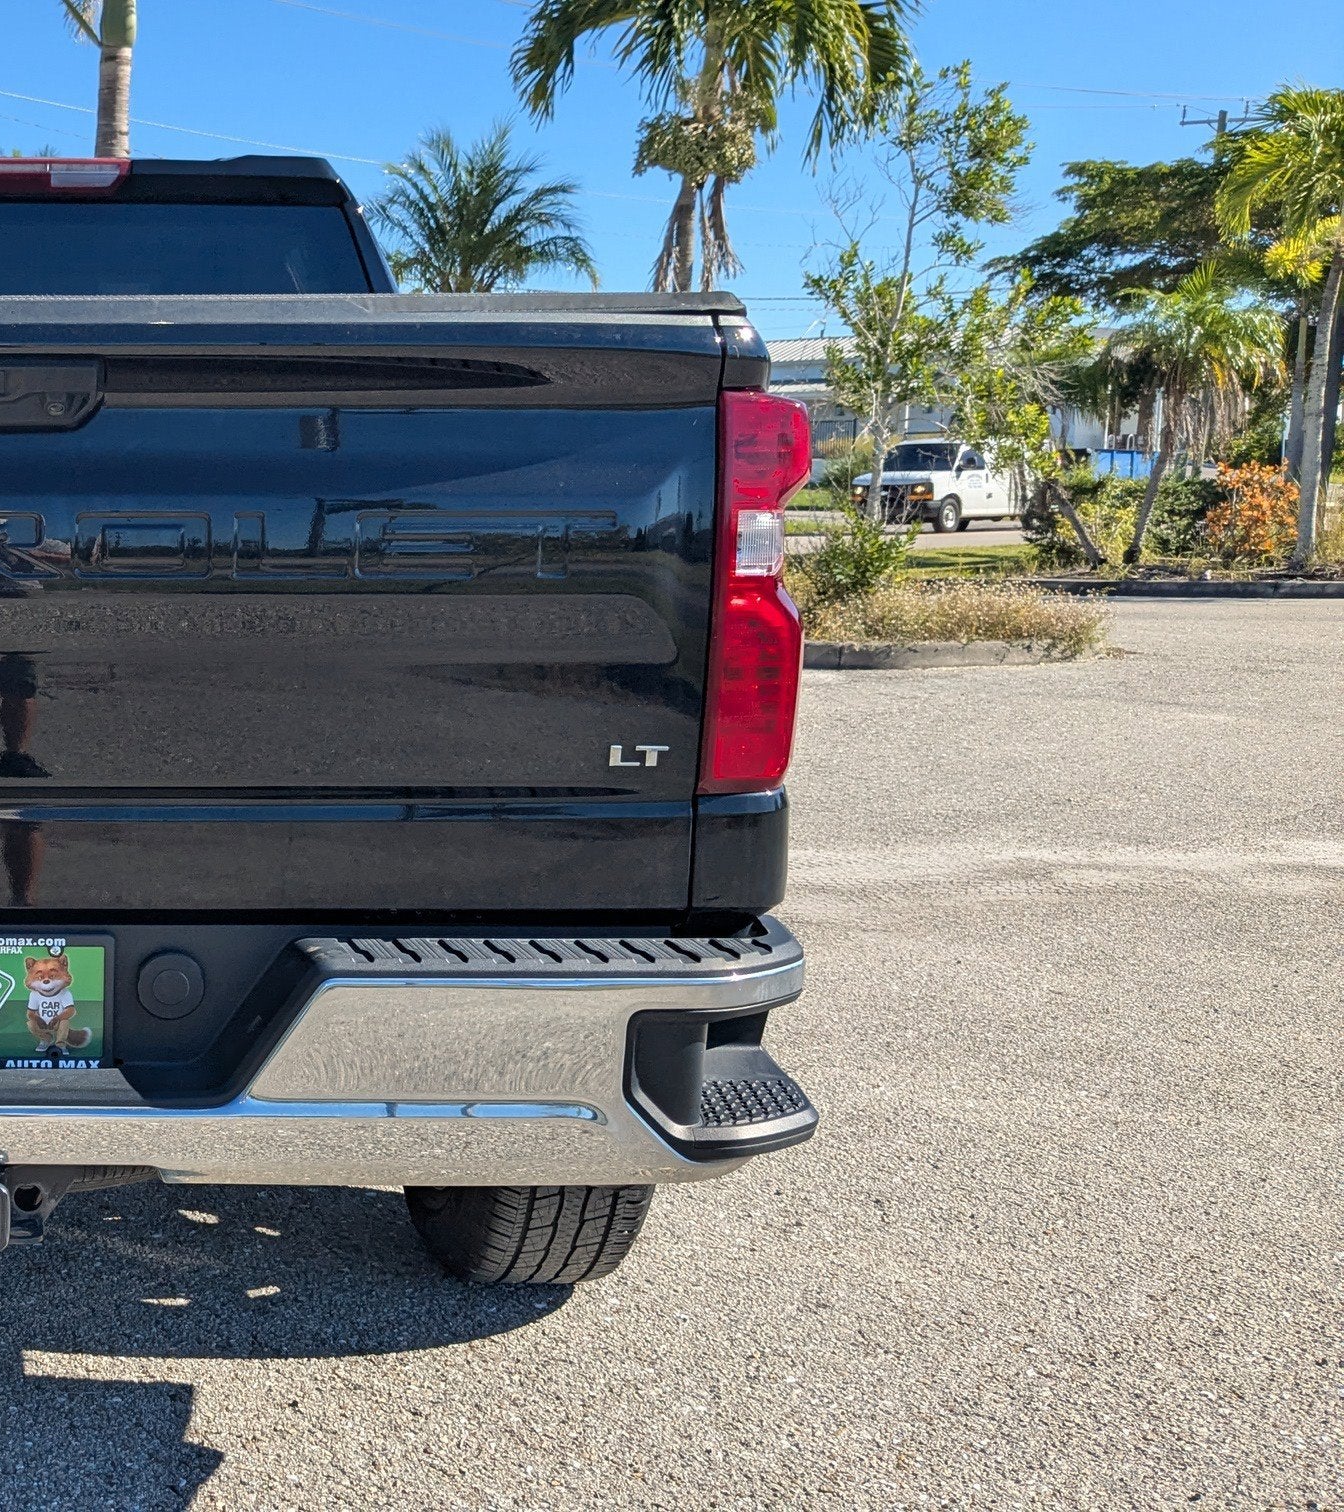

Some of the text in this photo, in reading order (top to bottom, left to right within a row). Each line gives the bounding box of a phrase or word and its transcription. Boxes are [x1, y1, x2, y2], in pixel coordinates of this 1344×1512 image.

[609, 745, 670, 767] LT
[41, 1001, 60, 1009] CAR
[41, 1010, 59, 1018] FOX
[58, 1060, 100, 1069] MAX
